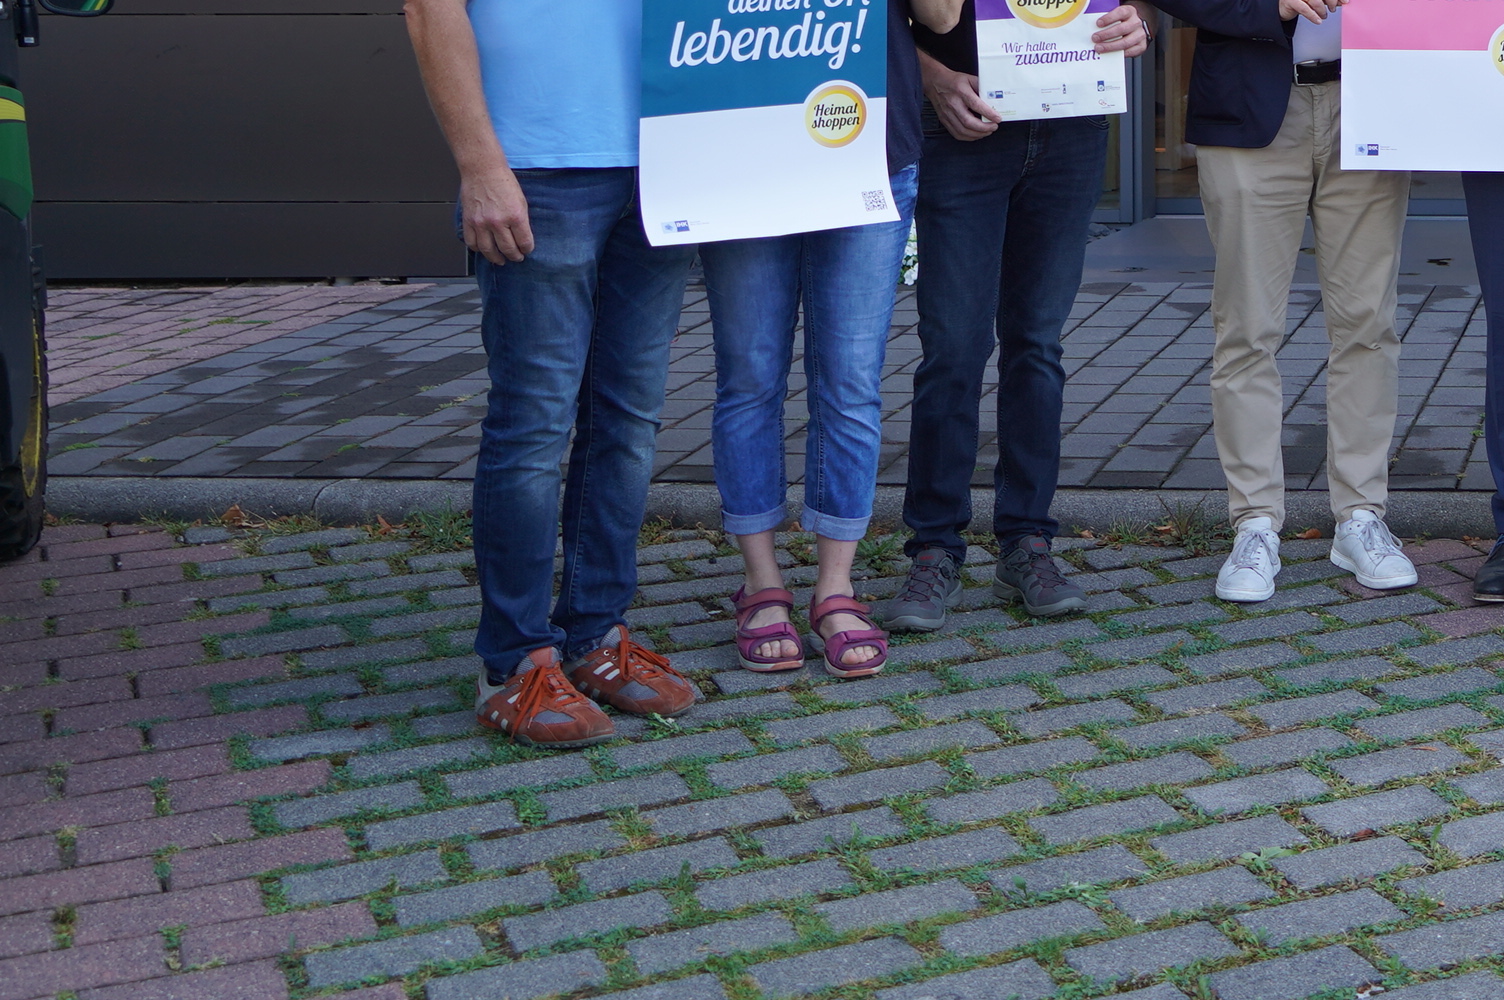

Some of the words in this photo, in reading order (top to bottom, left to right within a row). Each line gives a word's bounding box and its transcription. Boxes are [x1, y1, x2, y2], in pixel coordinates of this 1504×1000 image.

[669, 8, 868, 70] lebendig!
[1002, 42, 1024, 54] Wir
[1025, 41, 1057, 52] halten
[814, 103, 858, 117] Heimat
[811, 116, 860, 131] shoppen
